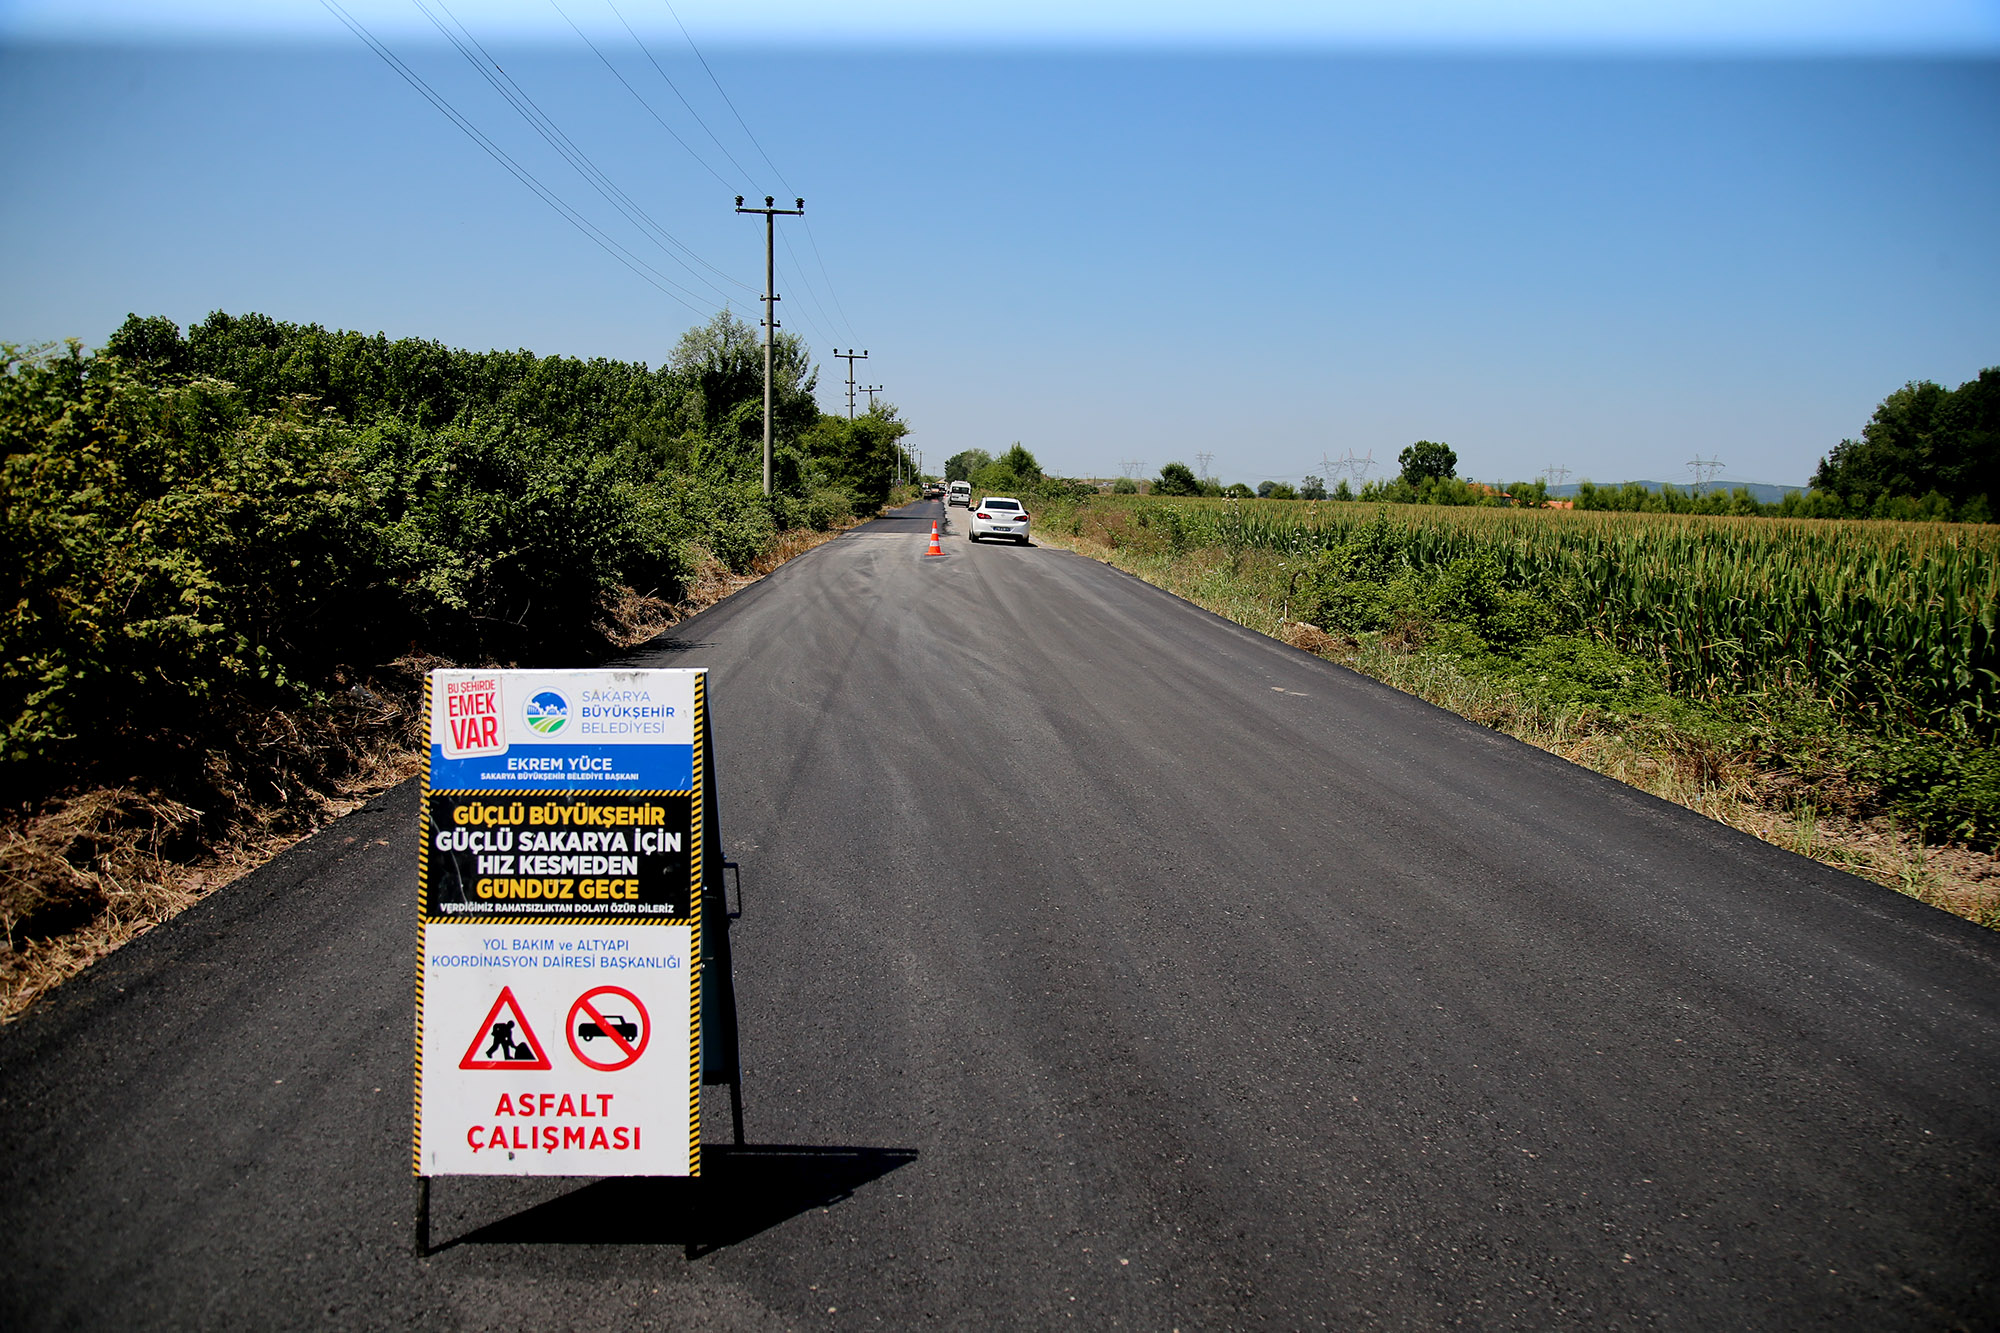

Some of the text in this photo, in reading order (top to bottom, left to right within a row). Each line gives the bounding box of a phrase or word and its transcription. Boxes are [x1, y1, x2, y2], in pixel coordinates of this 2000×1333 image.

[448, 683, 459, 694] BU
[582, 691, 650, 702] SAKARYA
[449, 693, 496, 717] EMEK
[582, 704, 675, 719] BÜYÜKŞEHİR
[450, 716, 498, 750] VAR
[582, 720, 665, 734] BELEDİYESİ
[507, 755, 612, 771] EKREM YÜCE
[517, 772, 565, 781] BÜYÜKŞEHİR
[567, 772, 603, 780] BELEDİYE
[605, 773, 639, 781] BAŞKANI
[453, 803, 665, 828] GÜÇLÜ BÜYÜKŞEHİR
[436, 828, 681, 855] GÜÇLÜ SAKARYA İÇİN
[477, 855, 638, 875] HIZ KESMEDEN
[476, 878, 639, 899] GÜNDÜZ GECE
[440, 902, 674, 914] VERDİĞİMİZ RAHATSIZLIKTAN DOLAYI ÖZÜR DİLERİZ
[483, 939, 629, 951] YOL BAKIM ve ALTYAPI
[432, 953, 680, 970] KOORDİNASYON DAİRESİ BAŞKANLIĞI
[495, 1093, 614, 1117] ASFALT
[467, 1125, 641, 1154] ÇALIŞMASI
